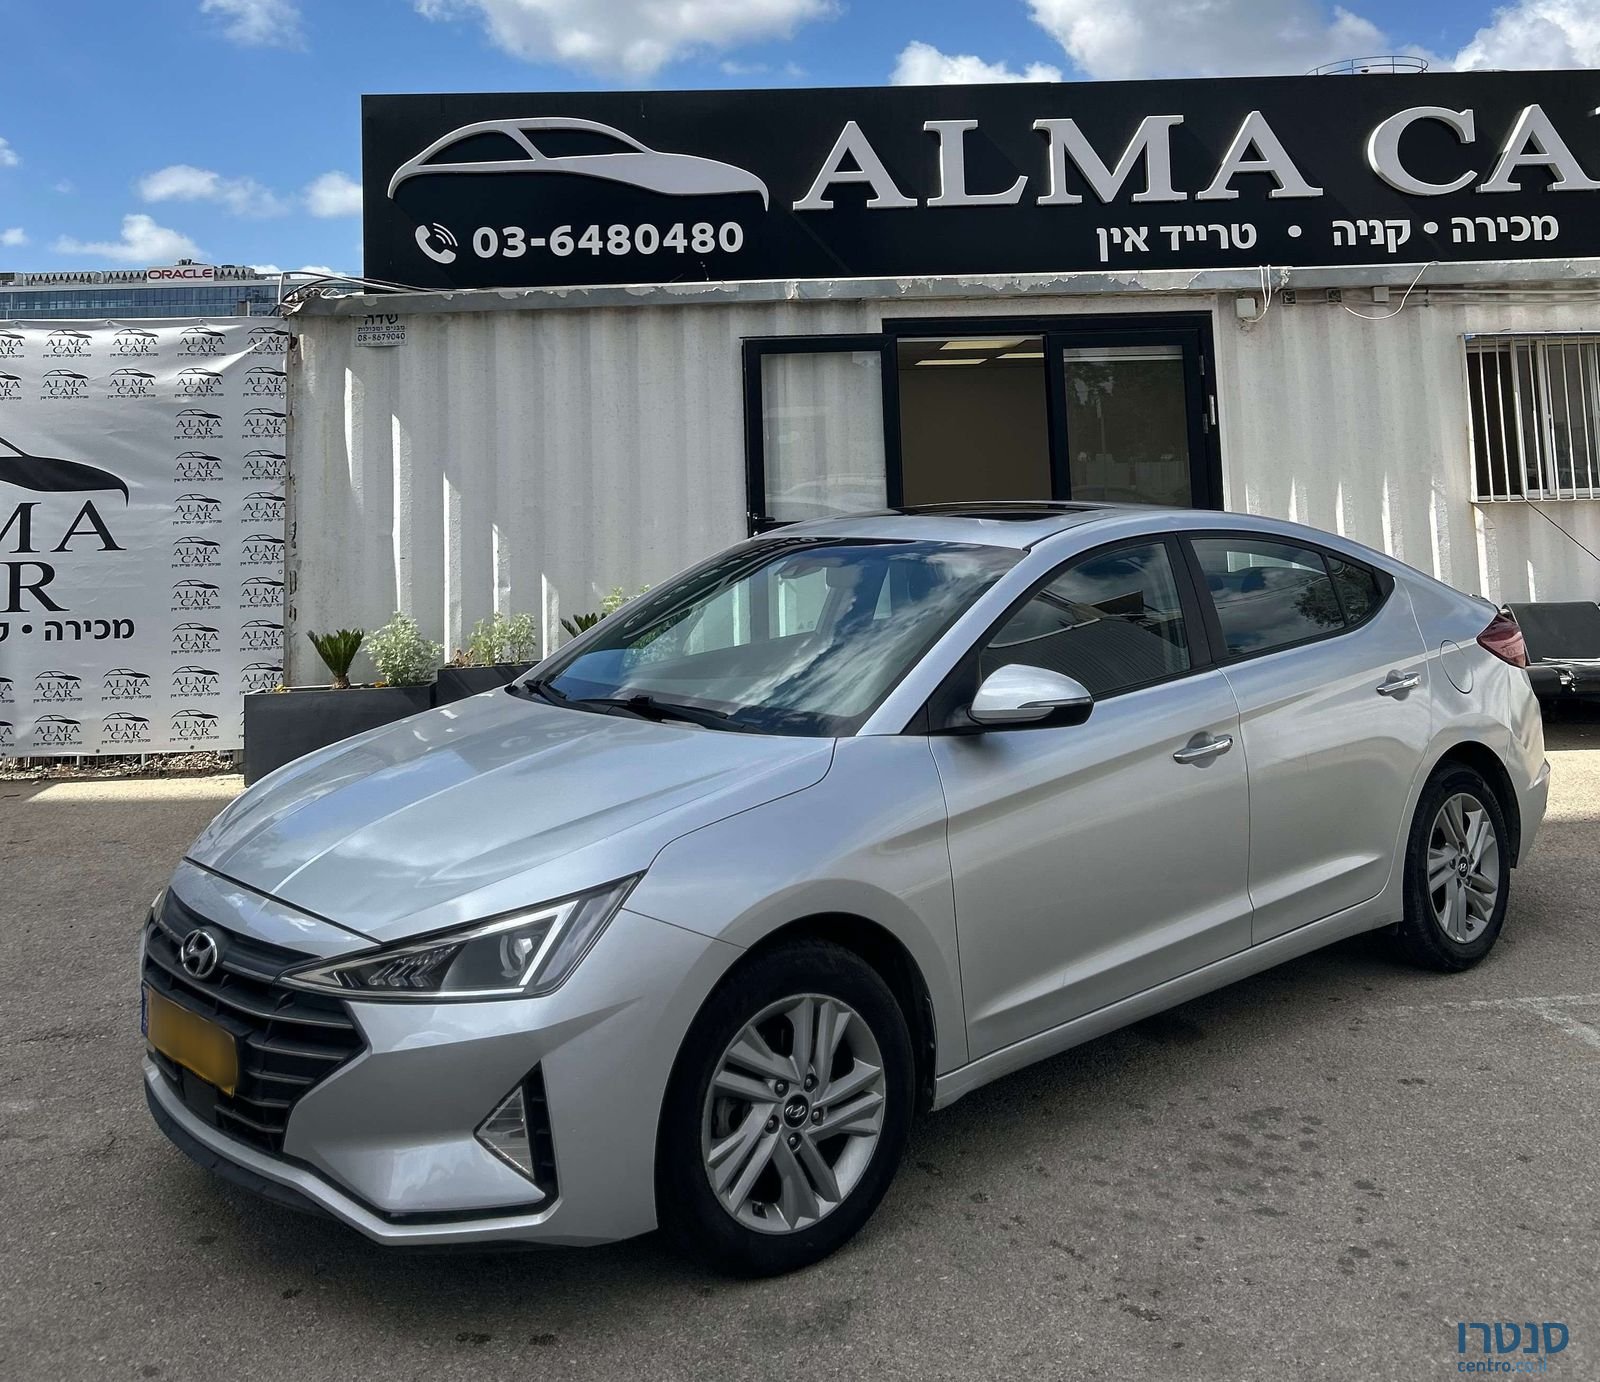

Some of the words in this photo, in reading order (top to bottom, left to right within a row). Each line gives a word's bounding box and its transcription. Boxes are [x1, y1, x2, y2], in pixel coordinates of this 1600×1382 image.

[793, 110, 1324, 211] ALMA
[1367, 103, 1600, 196] CA
[1451, 215, 1559, 243] מכירה
[472, 221, 744, 258] 03-6480480
[1160, 223, 1257, 251] טרייד
[1332, 219, 1411, 253] קניה
[1096, 226, 1150, 262] אין
[148, 269, 213, 279] ORACLE
[364, 314, 398, 325] שדה
[180, 337, 224, 345] ALMA
[358, 332, 405, 341] 08-8679040
[53, 346, 82, 354] CAR
[120, 345, 149, 353] CAR
[43, 380, 87, 388] ALMA
[109, 379, 154, 387] ALMA
[177, 377, 223, 386] ALMA
[184, 385, 214, 393] CAR
[183, 427, 213, 435] CAR
[251, 426, 281, 434] CAR
[176, 462, 221, 470] ALMA
[251, 468, 281, 476] CAR
[175, 504, 220, 512] ALMA
[182, 512, 212, 520] CAR
[251, 510, 280, 518] CAR
[174, 547, 219, 556] ALMA
[181, 555, 211, 563] CAR
[250, 552, 279, 561] CAR
[173, 590, 218, 599] ALMA
[180, 598, 211, 606] CAR
[249, 595, 279, 604] CAR
[44, 618, 135, 641] מכירה
[173, 633, 218, 642] ALMA
[180, 641, 211, 649] CAR
[249, 638, 279, 647] CAR
[104, 679, 149, 688] ALMA
[172, 676, 218, 685] ALMA
[249, 681, 278, 689] CAR
[35, 682, 80, 690] ALMA
[180, 684, 210, 693] CAR
[43, 690, 73, 698] CAR
[111, 687, 141, 695] CAR
[103, 723, 148, 732] ALMA
[172, 720, 217, 729] ALMA
[35, 725, 80, 734] ALMA
[179, 728, 209, 736] CAR
[42, 733, 72, 742] CAR
[111, 731, 141, 739] CAR
